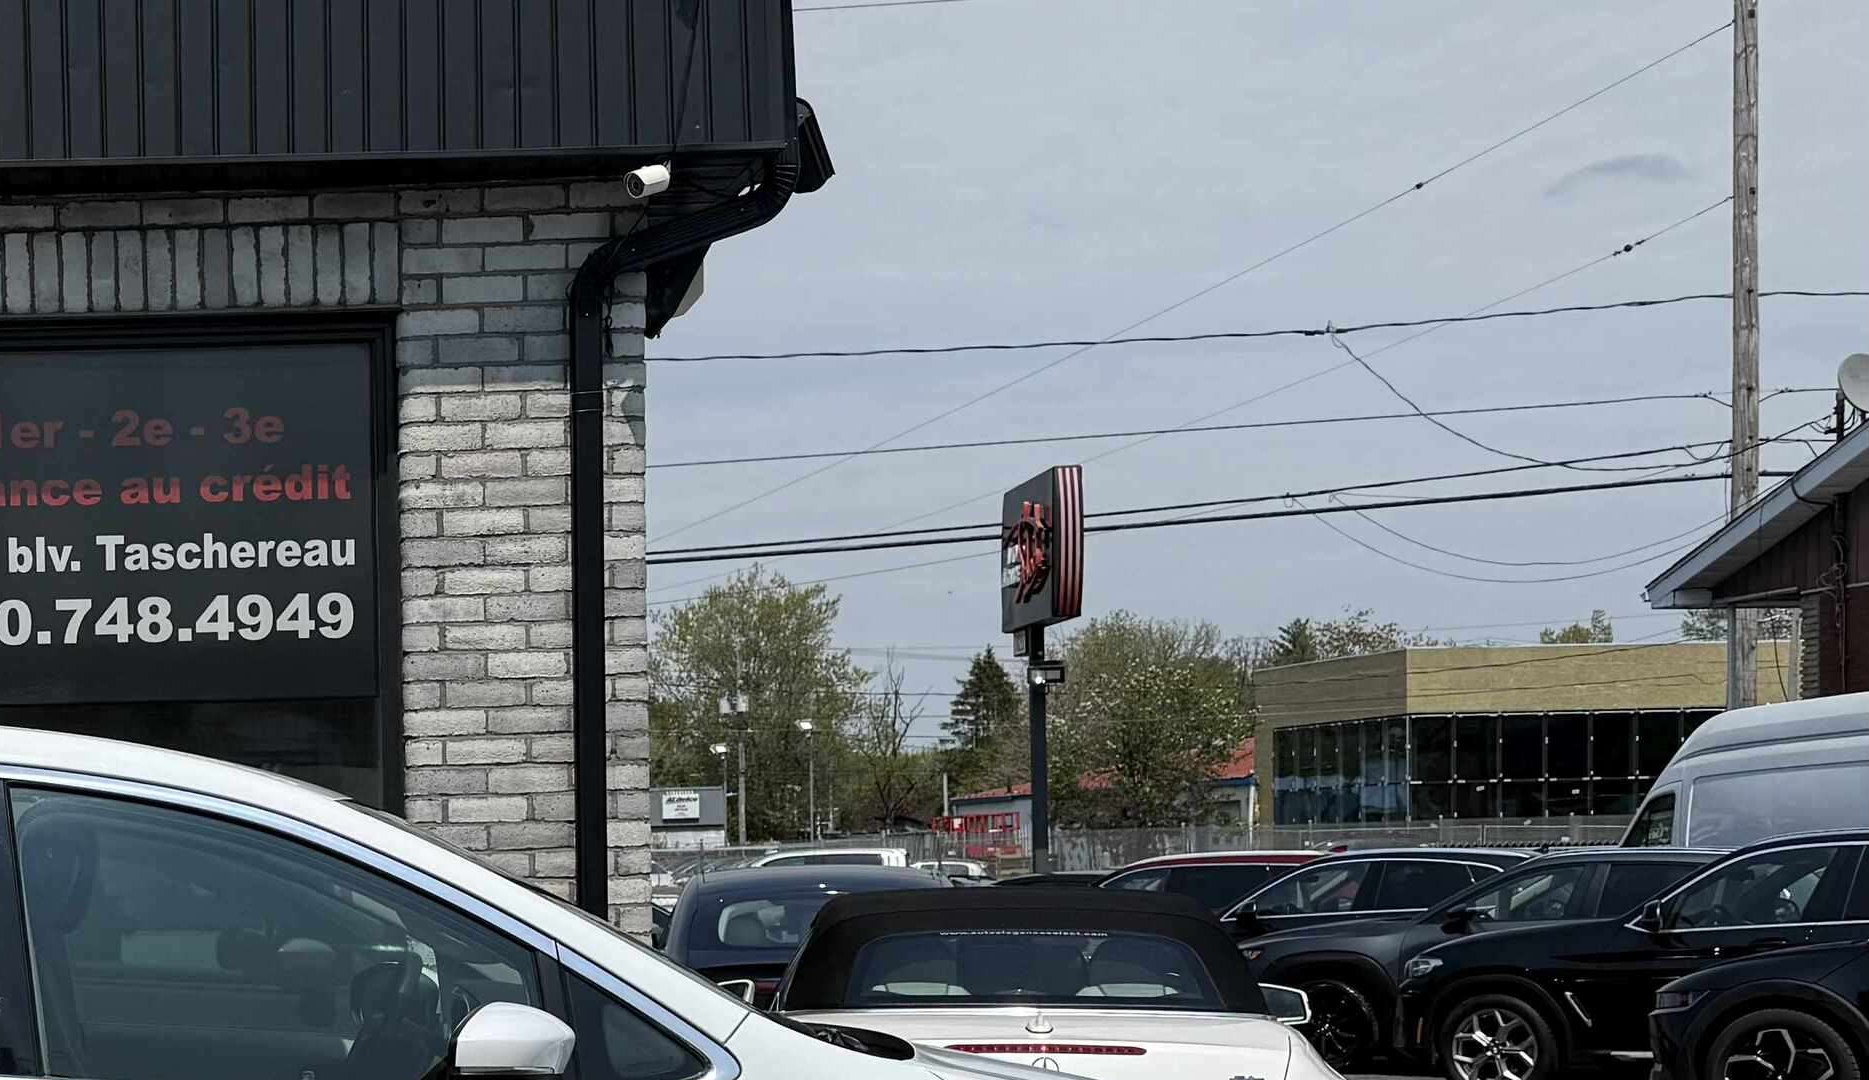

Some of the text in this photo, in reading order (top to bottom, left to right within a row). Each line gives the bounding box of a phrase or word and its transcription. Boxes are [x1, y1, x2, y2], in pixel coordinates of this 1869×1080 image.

[111, 409, 174, 447] 2e
[222, 407, 285, 445] 3e
[120, 474, 182, 504] au
[199, 463, 352, 503] crédit
[7, 536, 81, 574] blv.
[95, 532, 357, 572] Taschereau
